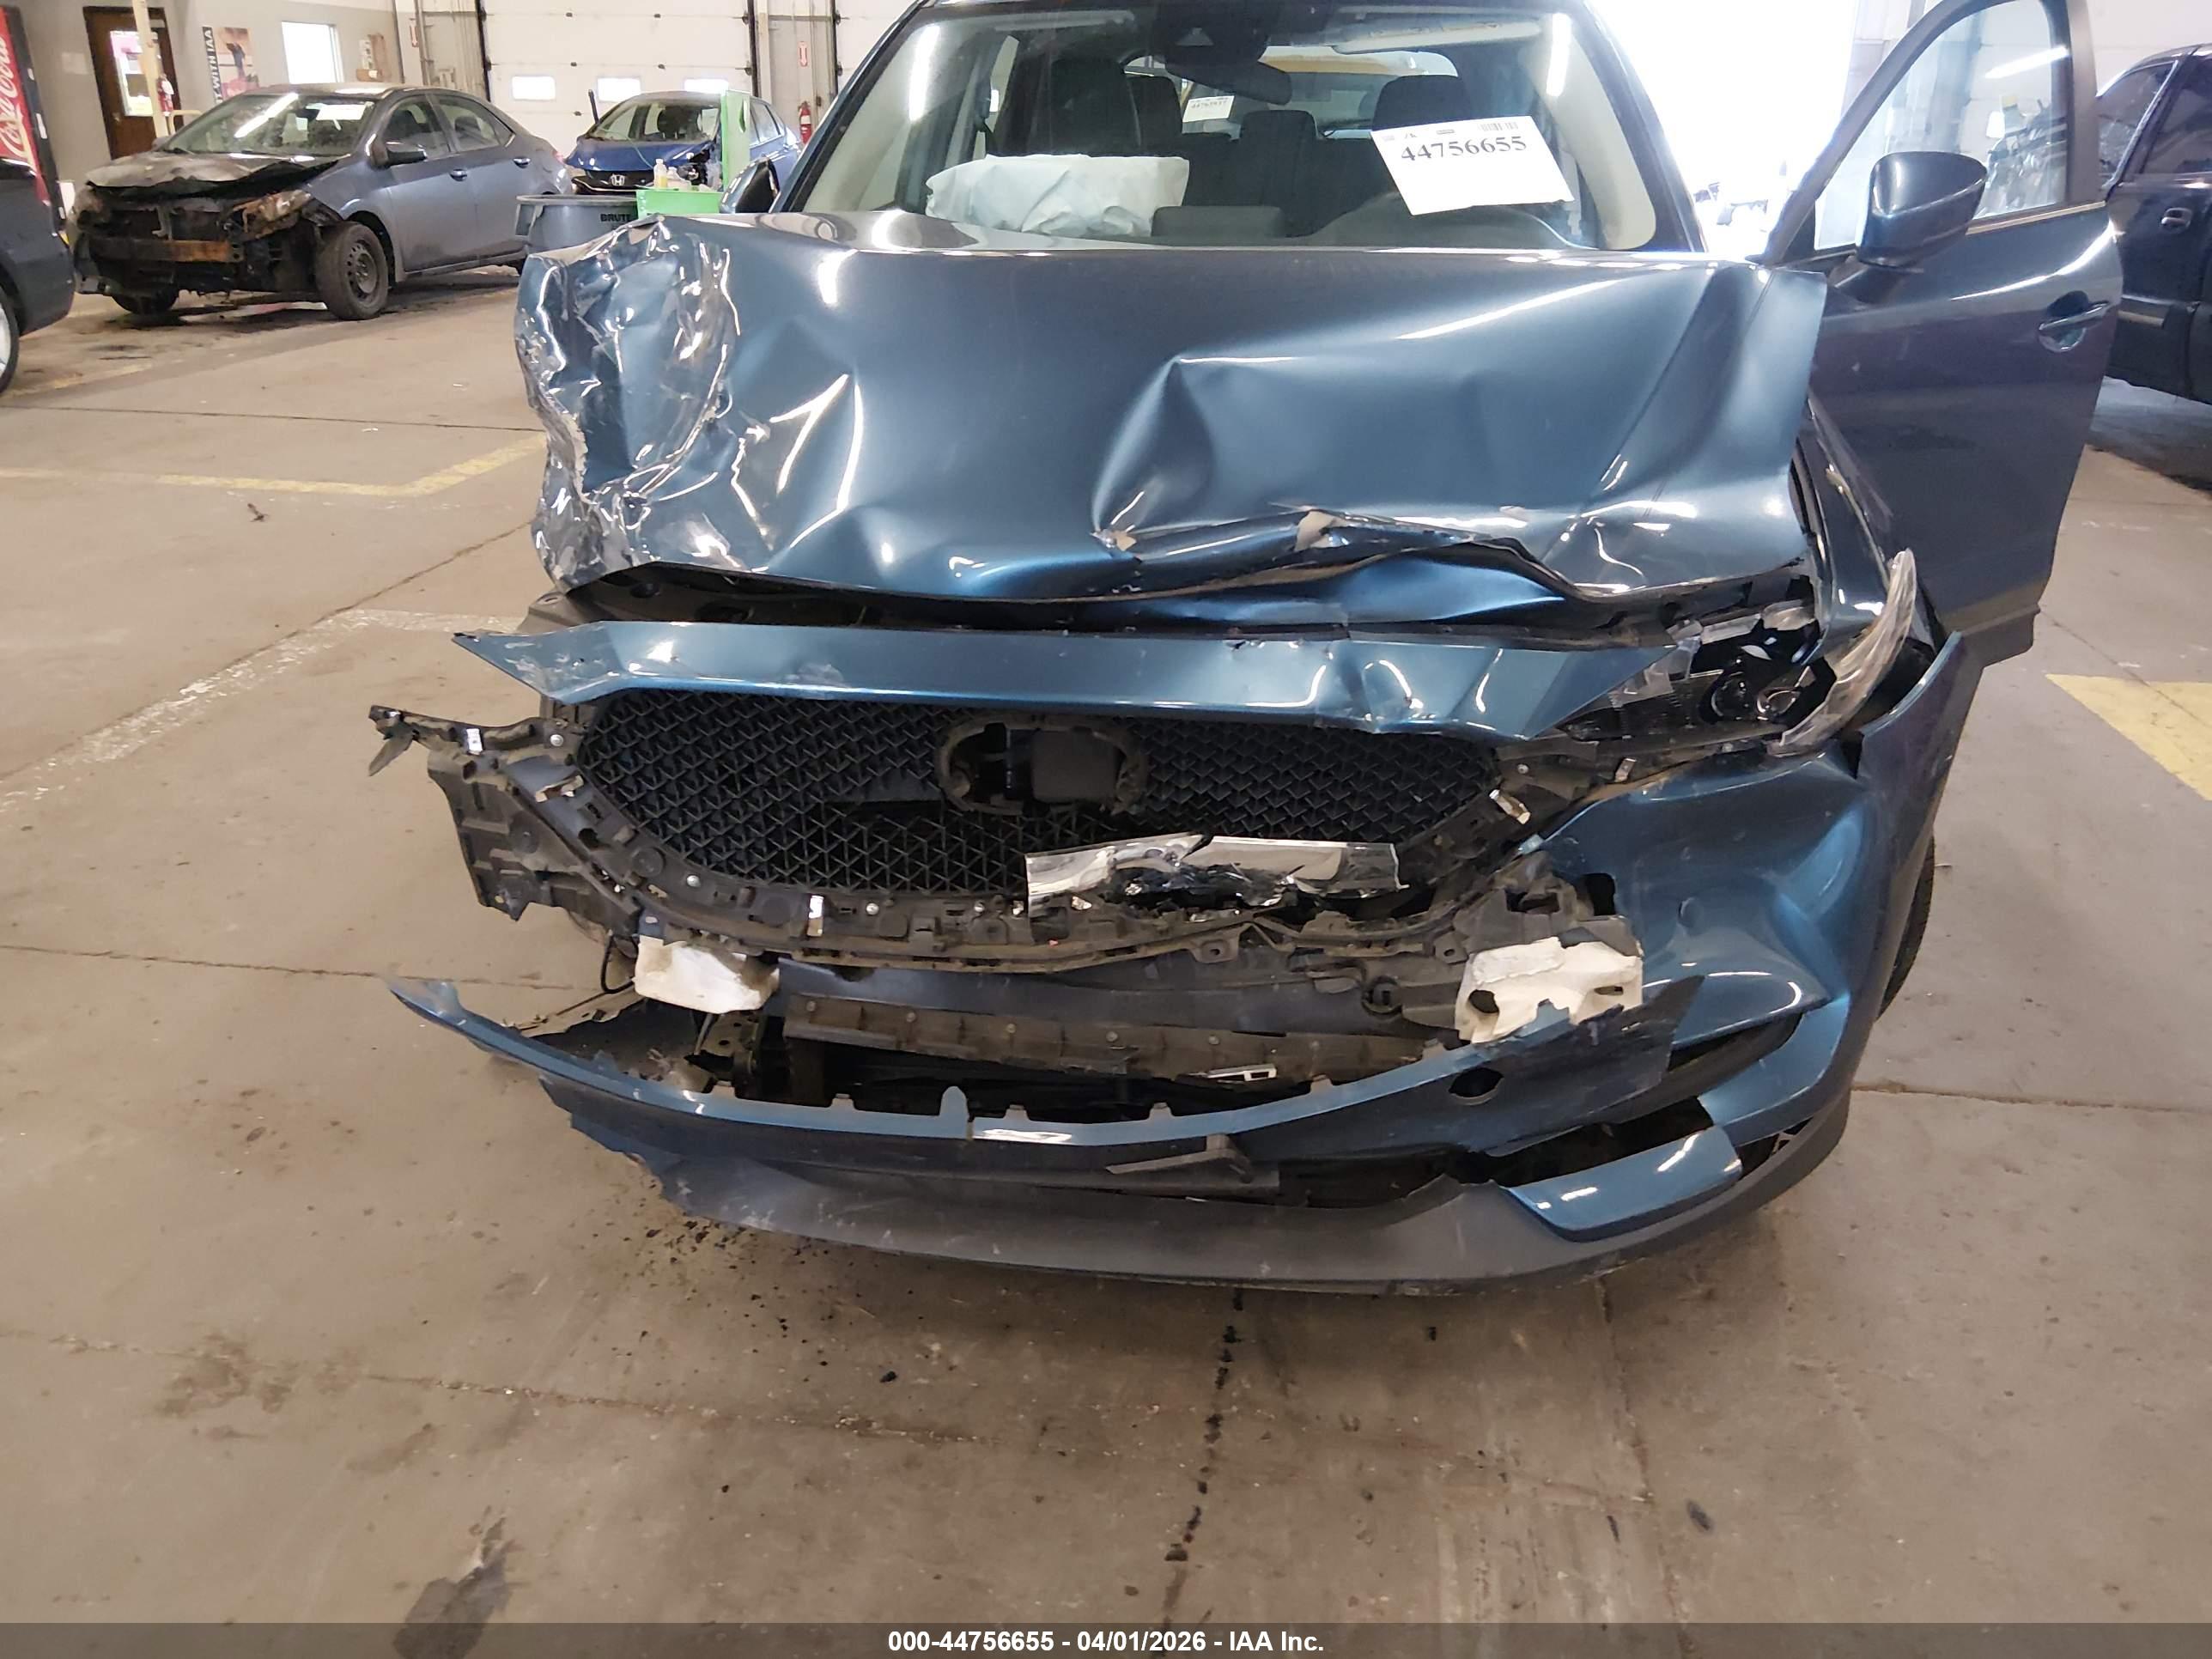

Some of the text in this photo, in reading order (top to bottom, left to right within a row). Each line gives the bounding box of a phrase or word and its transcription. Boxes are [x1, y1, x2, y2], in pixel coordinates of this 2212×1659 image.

[204, 30, 216, 52] IAA
[208, 55, 222, 89] WITH
[1401, 136, 1527, 161] 44756655
